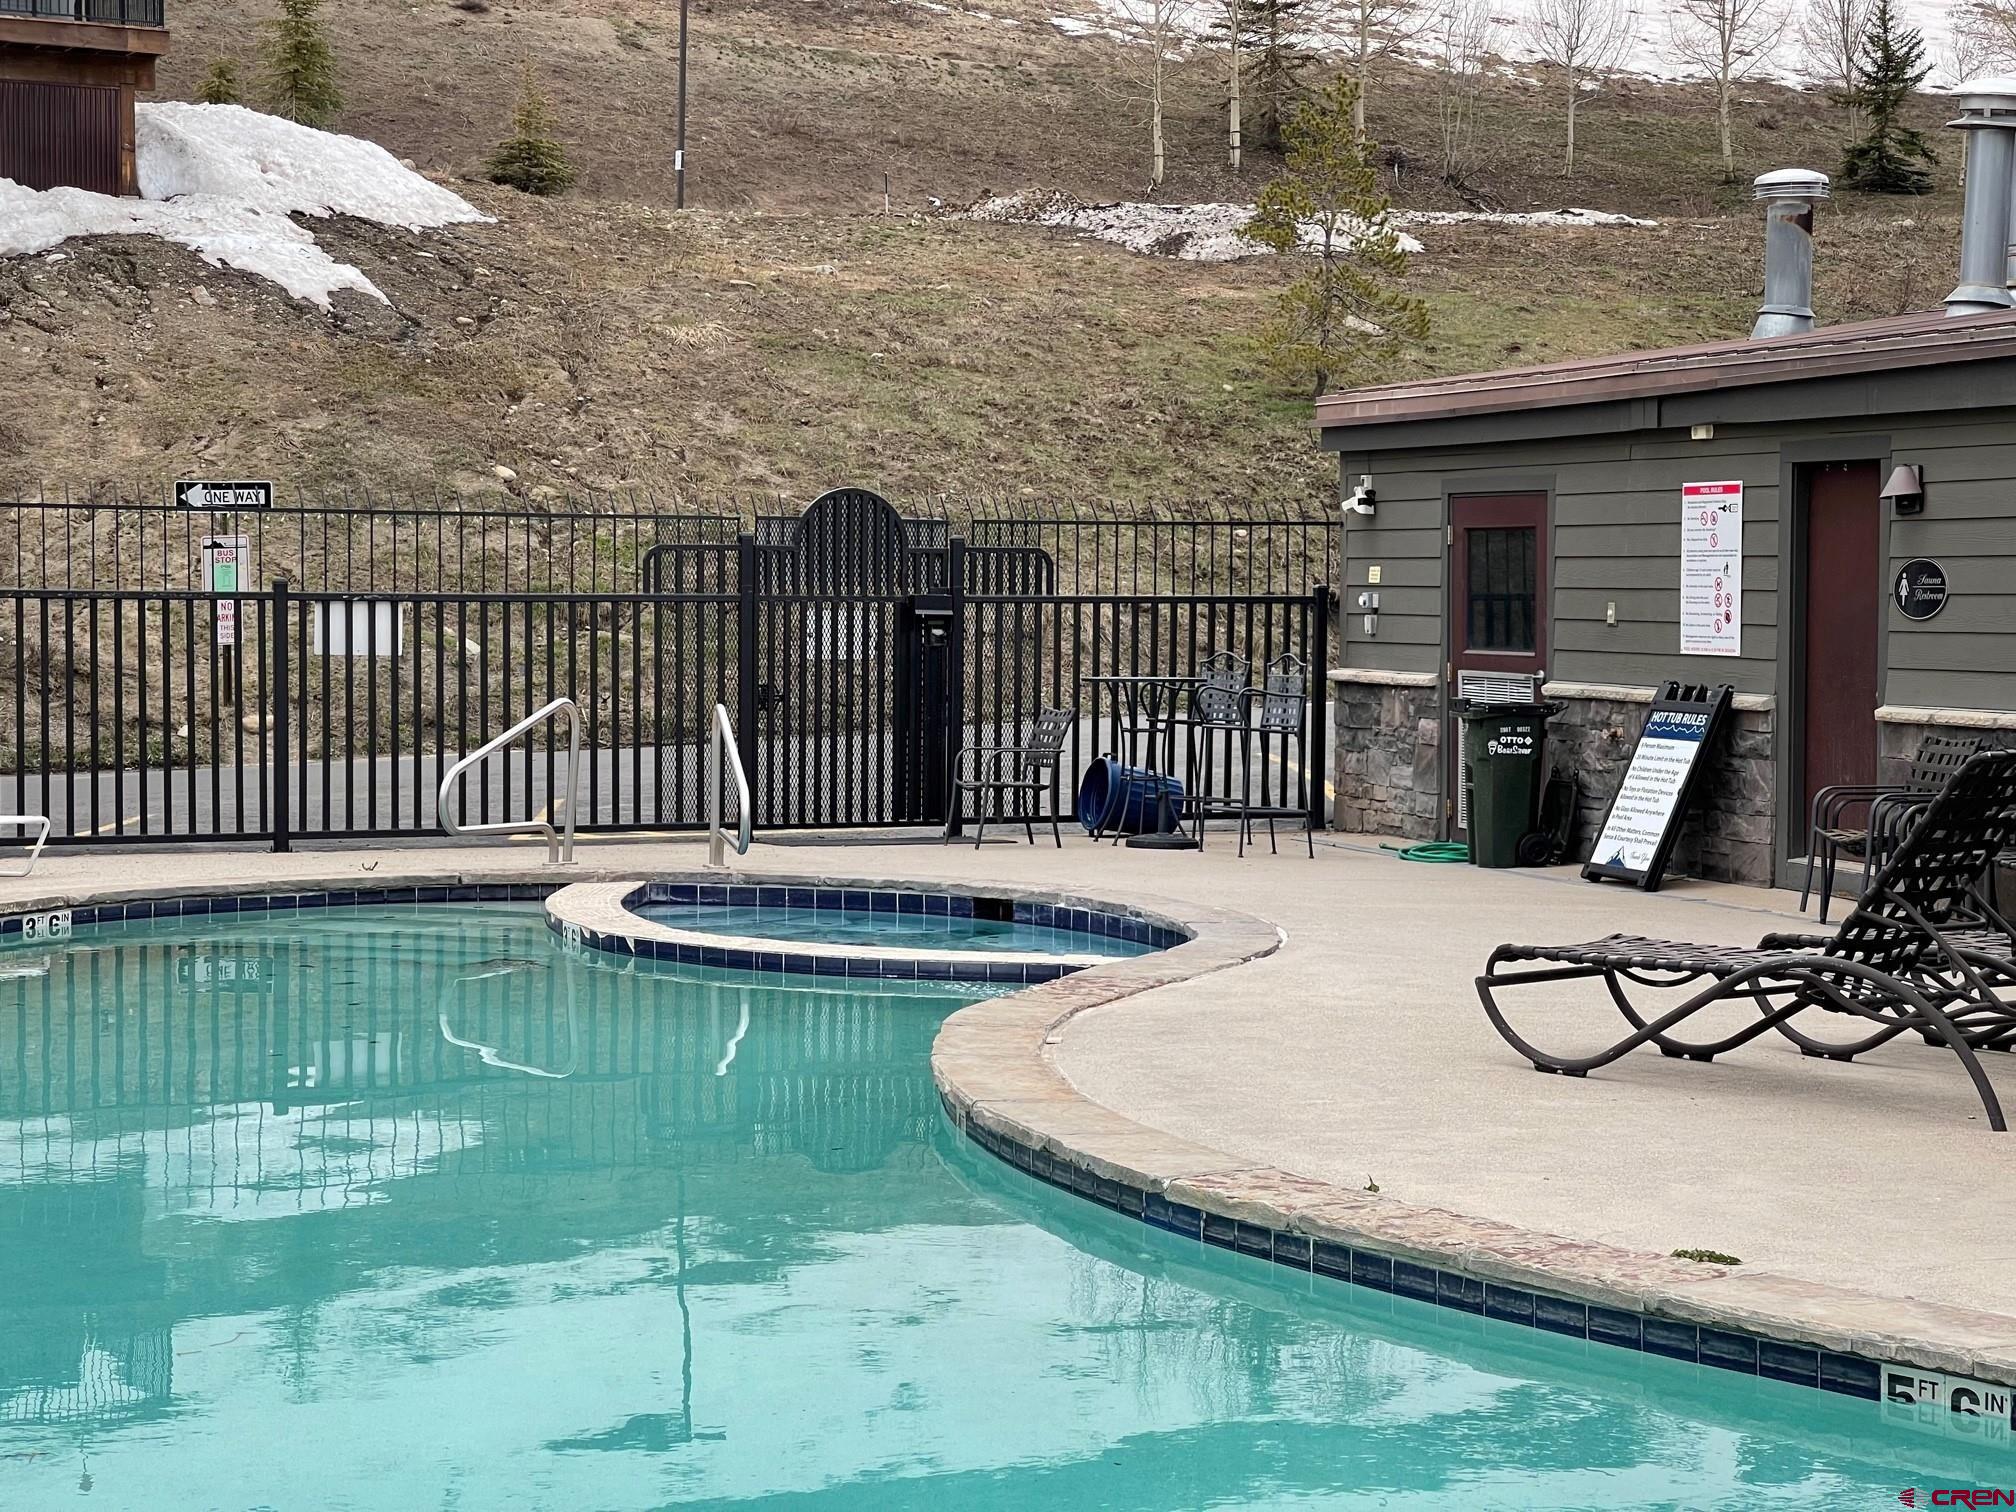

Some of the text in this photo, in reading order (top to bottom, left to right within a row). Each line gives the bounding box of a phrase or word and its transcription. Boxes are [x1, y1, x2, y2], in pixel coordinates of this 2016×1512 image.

[204, 491, 261, 503] ONE WAY
[1917, 573, 1942, 585] Sauna
[1913, 588, 1944, 602] Restroom
[221, 602, 233, 611] NO
[1651, 711, 1708, 726] HOT TUB RULES
[1500, 736, 1524, 744] OTTO
[37, 916, 44, 924] FT
[62, 913, 70, 922] IN
[1887, 1372, 1917, 1405] 5
[1919, 1378, 1939, 1400] FT
[1984, 1391, 2006, 1414] IN
